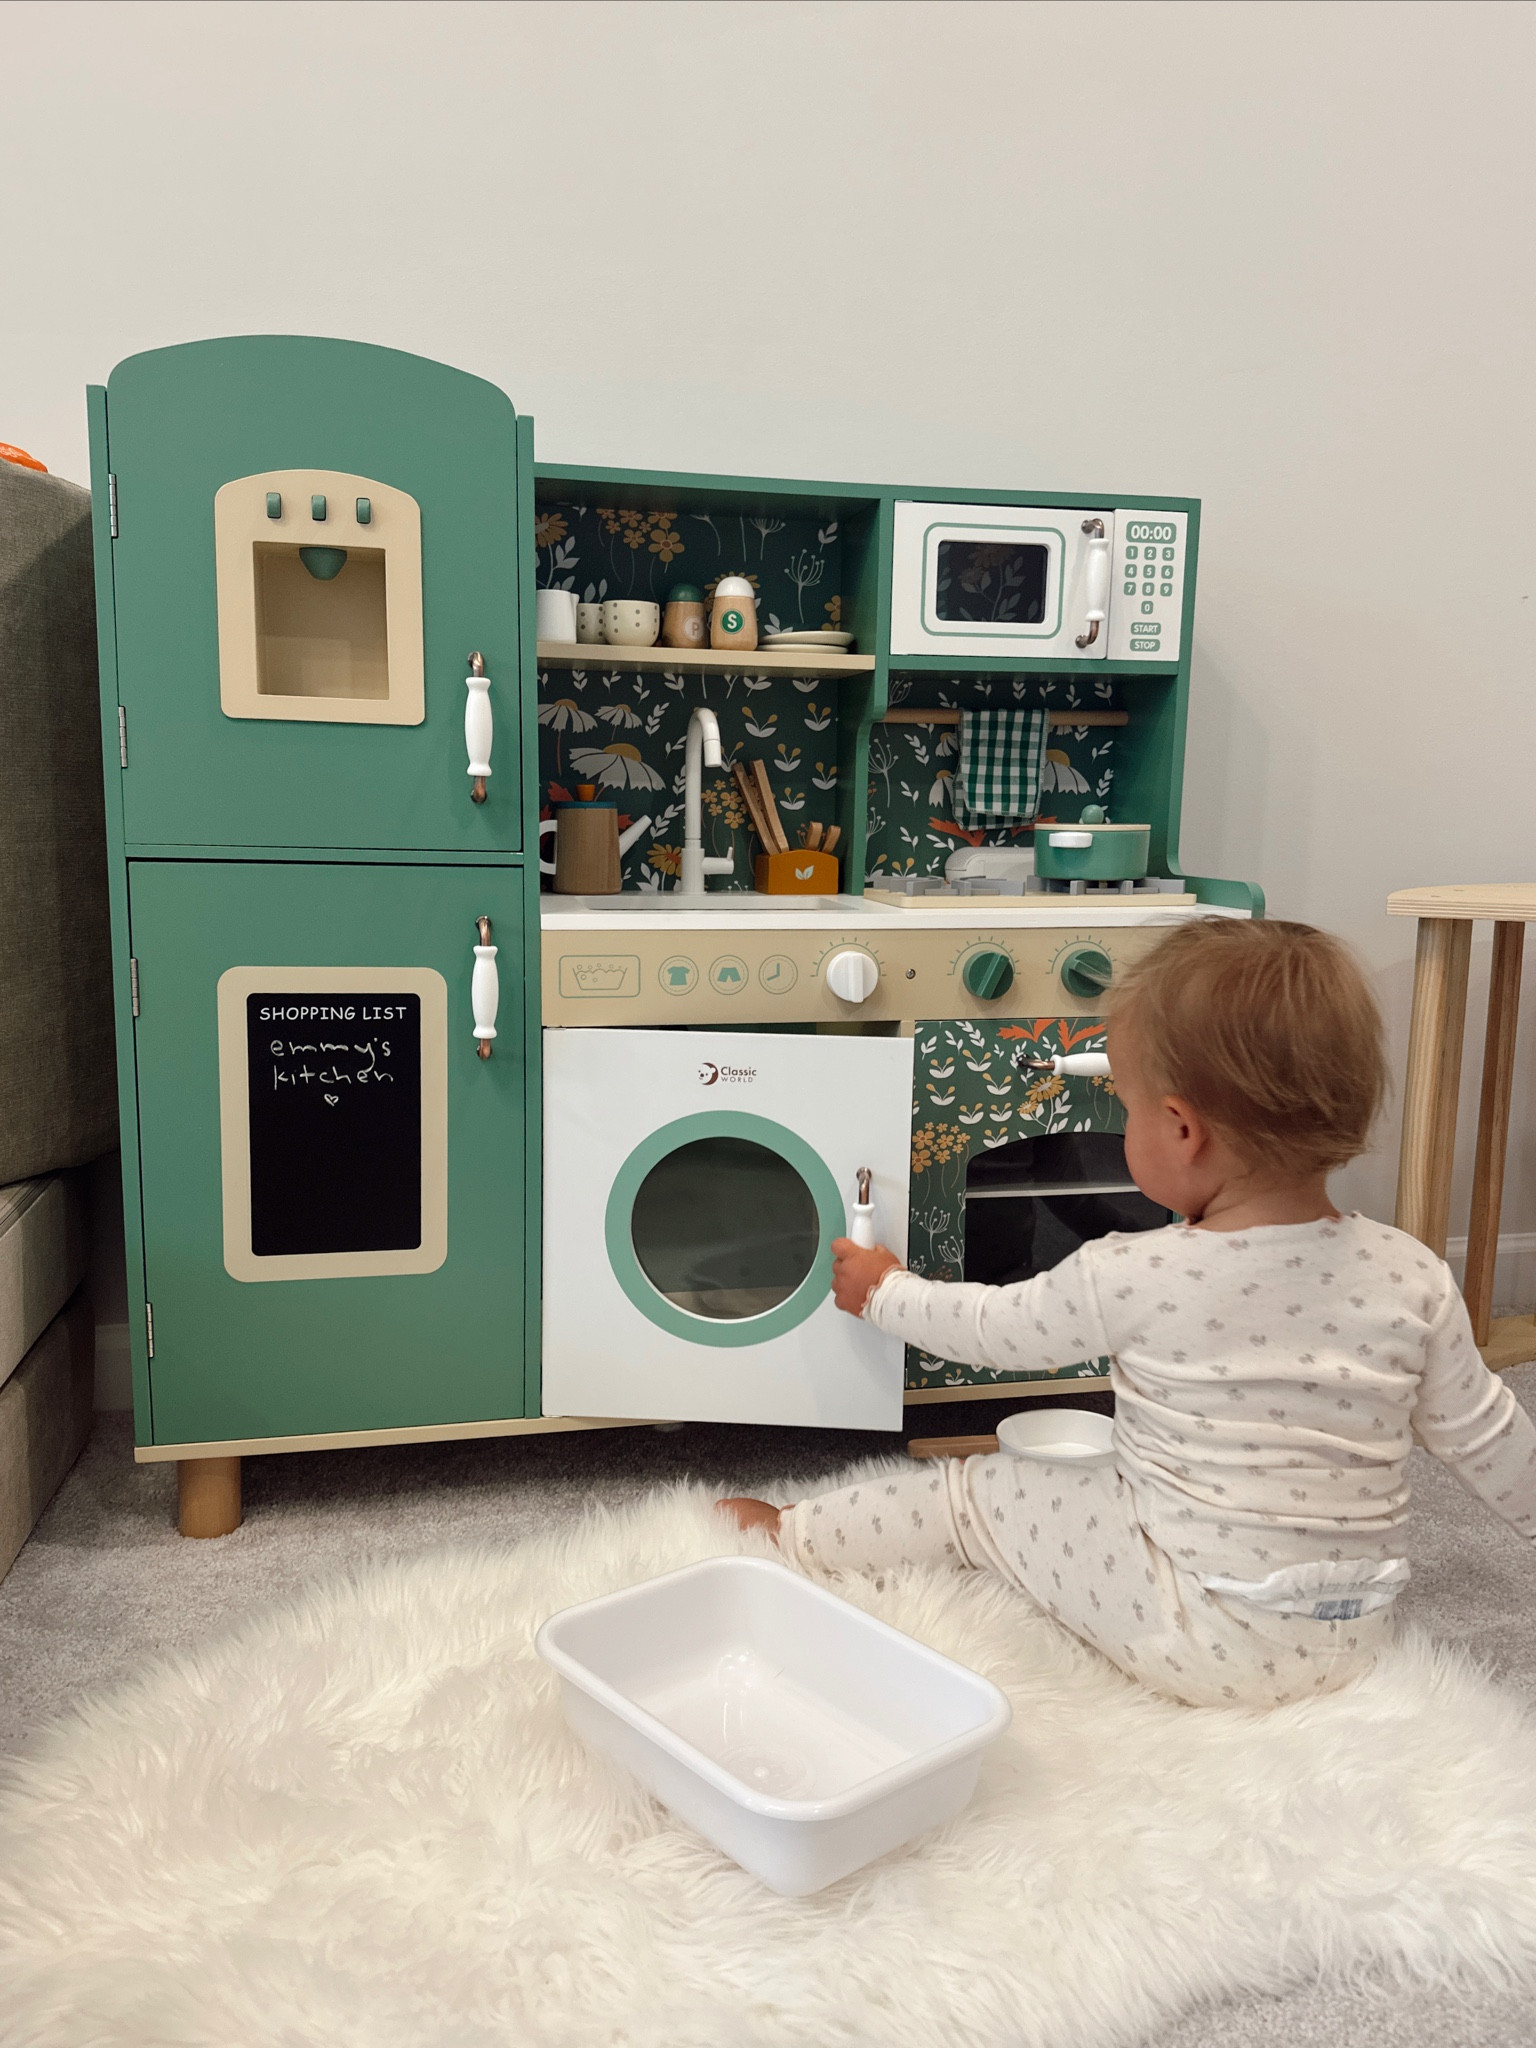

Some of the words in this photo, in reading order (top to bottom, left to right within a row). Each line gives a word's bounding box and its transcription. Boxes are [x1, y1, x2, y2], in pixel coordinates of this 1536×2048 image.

[1130, 525, 1172, 541] 00:00
[1147, 549, 1153, 558] 2
[1165, 550, 1171, 558] 3
[1128, 567, 1134, 575] 4
[1146, 568, 1152, 576] 5
[1164, 568, 1170, 577] 6
[1127, 585, 1133, 593] 7
[1145, 585, 1151, 594] 8
[1163, 586, 1169, 594] 9
[1144, 604, 1150, 612] 0
[727, 613, 737, 629] S
[692, 622, 700, 637] P
[1133, 624, 1158, 633] START
[1134, 641, 1156, 650] STOP
[259, 1006, 356, 1021] SHOPPING
[362, 1006, 407, 1020] LIST
[270, 1037, 391, 1073] emmy's
[720, 1066, 757, 1076] Classic
[273, 1064, 394, 1091] kitchen
